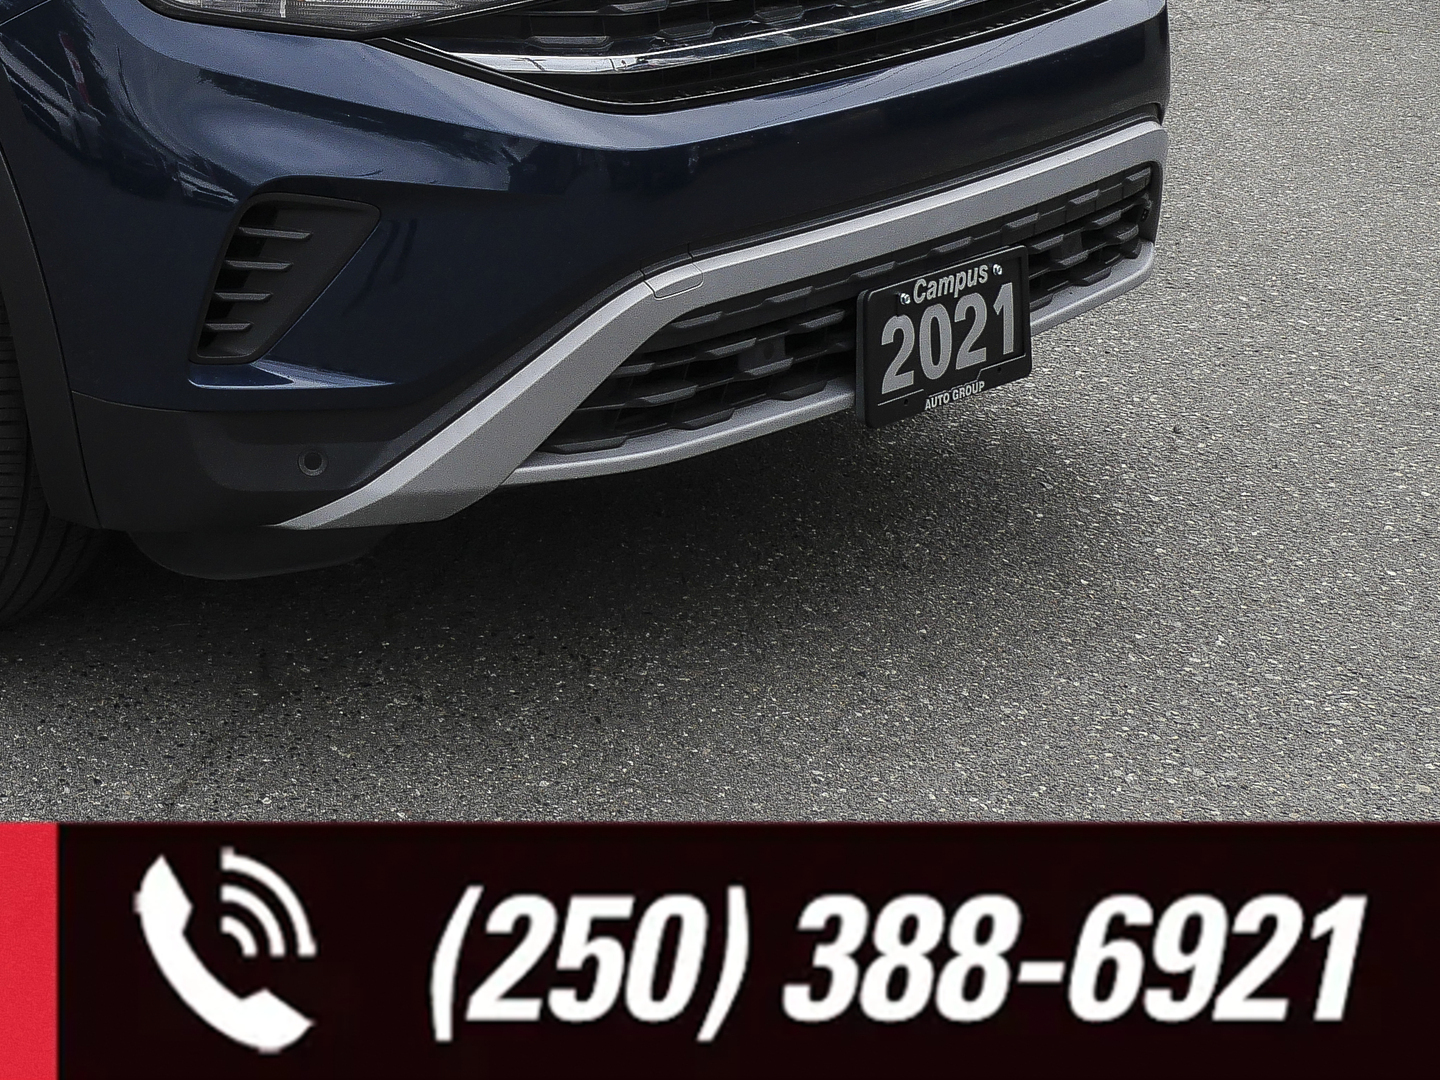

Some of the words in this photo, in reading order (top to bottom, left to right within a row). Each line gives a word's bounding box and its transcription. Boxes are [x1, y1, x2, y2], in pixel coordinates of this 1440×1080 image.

[913, 264, 988, 304] Campus
[881, 282, 1014, 395] 2021
[925, 394, 949, 411] AUTO
[952, 380, 985, 401] GROUP
